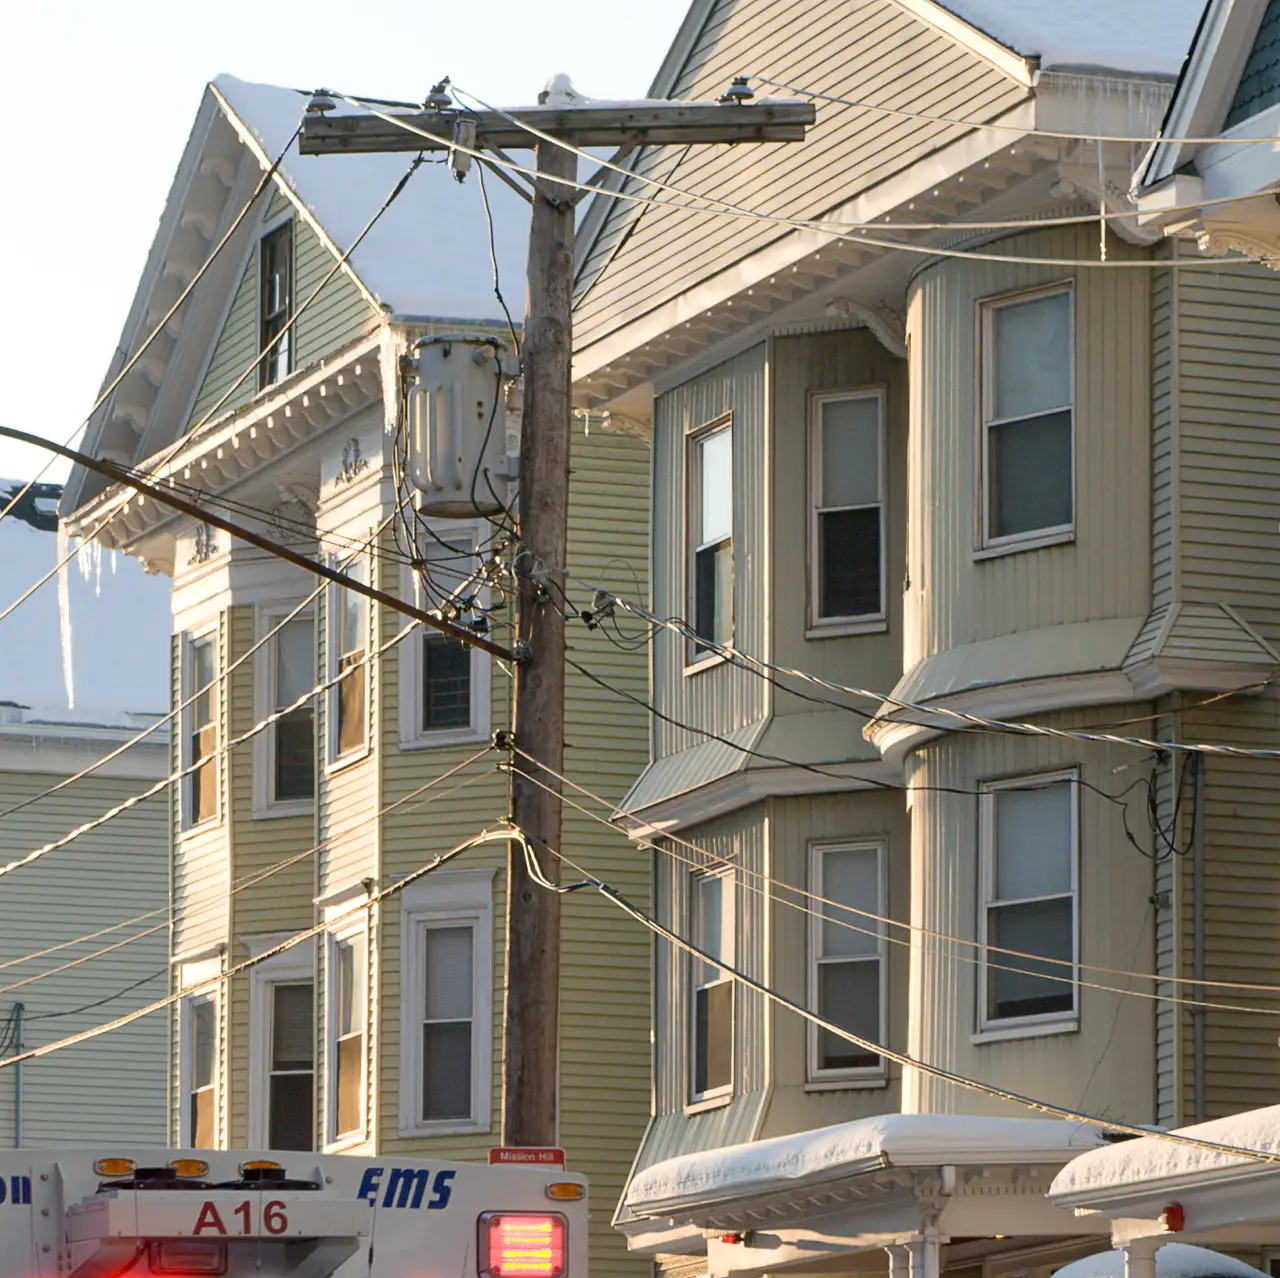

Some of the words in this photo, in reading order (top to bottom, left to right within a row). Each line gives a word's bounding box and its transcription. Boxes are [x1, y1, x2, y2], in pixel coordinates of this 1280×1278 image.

[500, 1151, 536, 1161] Mission
[538, 1151, 555, 1161] Hill
[357, 1167, 457, 1210] EMS
[191, 1199, 289, 1236] A16
